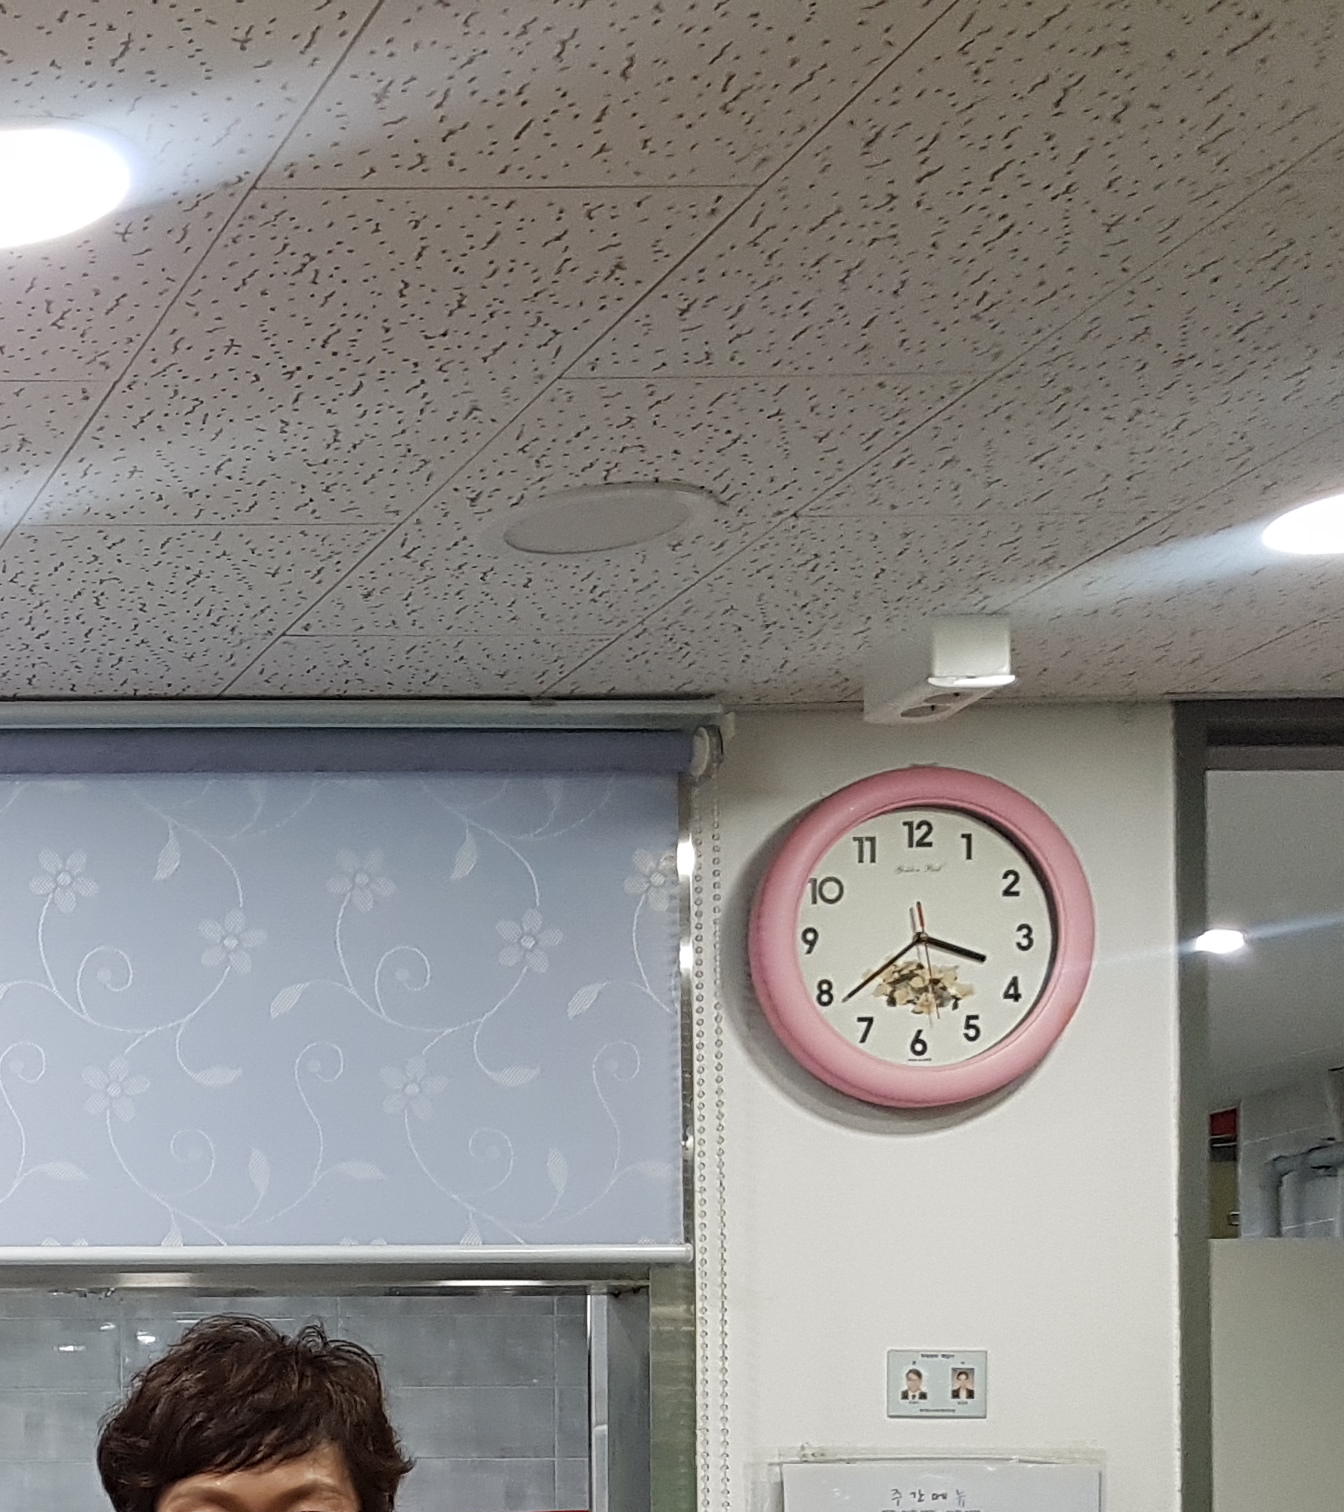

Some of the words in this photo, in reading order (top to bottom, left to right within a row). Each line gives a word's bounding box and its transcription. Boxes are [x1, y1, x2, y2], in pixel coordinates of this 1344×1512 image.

[903, 820, 933, 848] 12
[961, 833, 972, 860] 1
[853, 836, 876, 863] 11
[808, 877, 844, 904] 10
[1002, 870, 1020, 896] 2
[802, 928, 818, 954] 9
[1016, 924, 1033, 951] 3
[817, 979, 833, 1006] 8
[1003, 976, 1021, 1002] 4
[857, 1017, 873, 1043] 7
[964, 1015, 980, 1041] 5
[910, 1029, 927, 1056] 6
